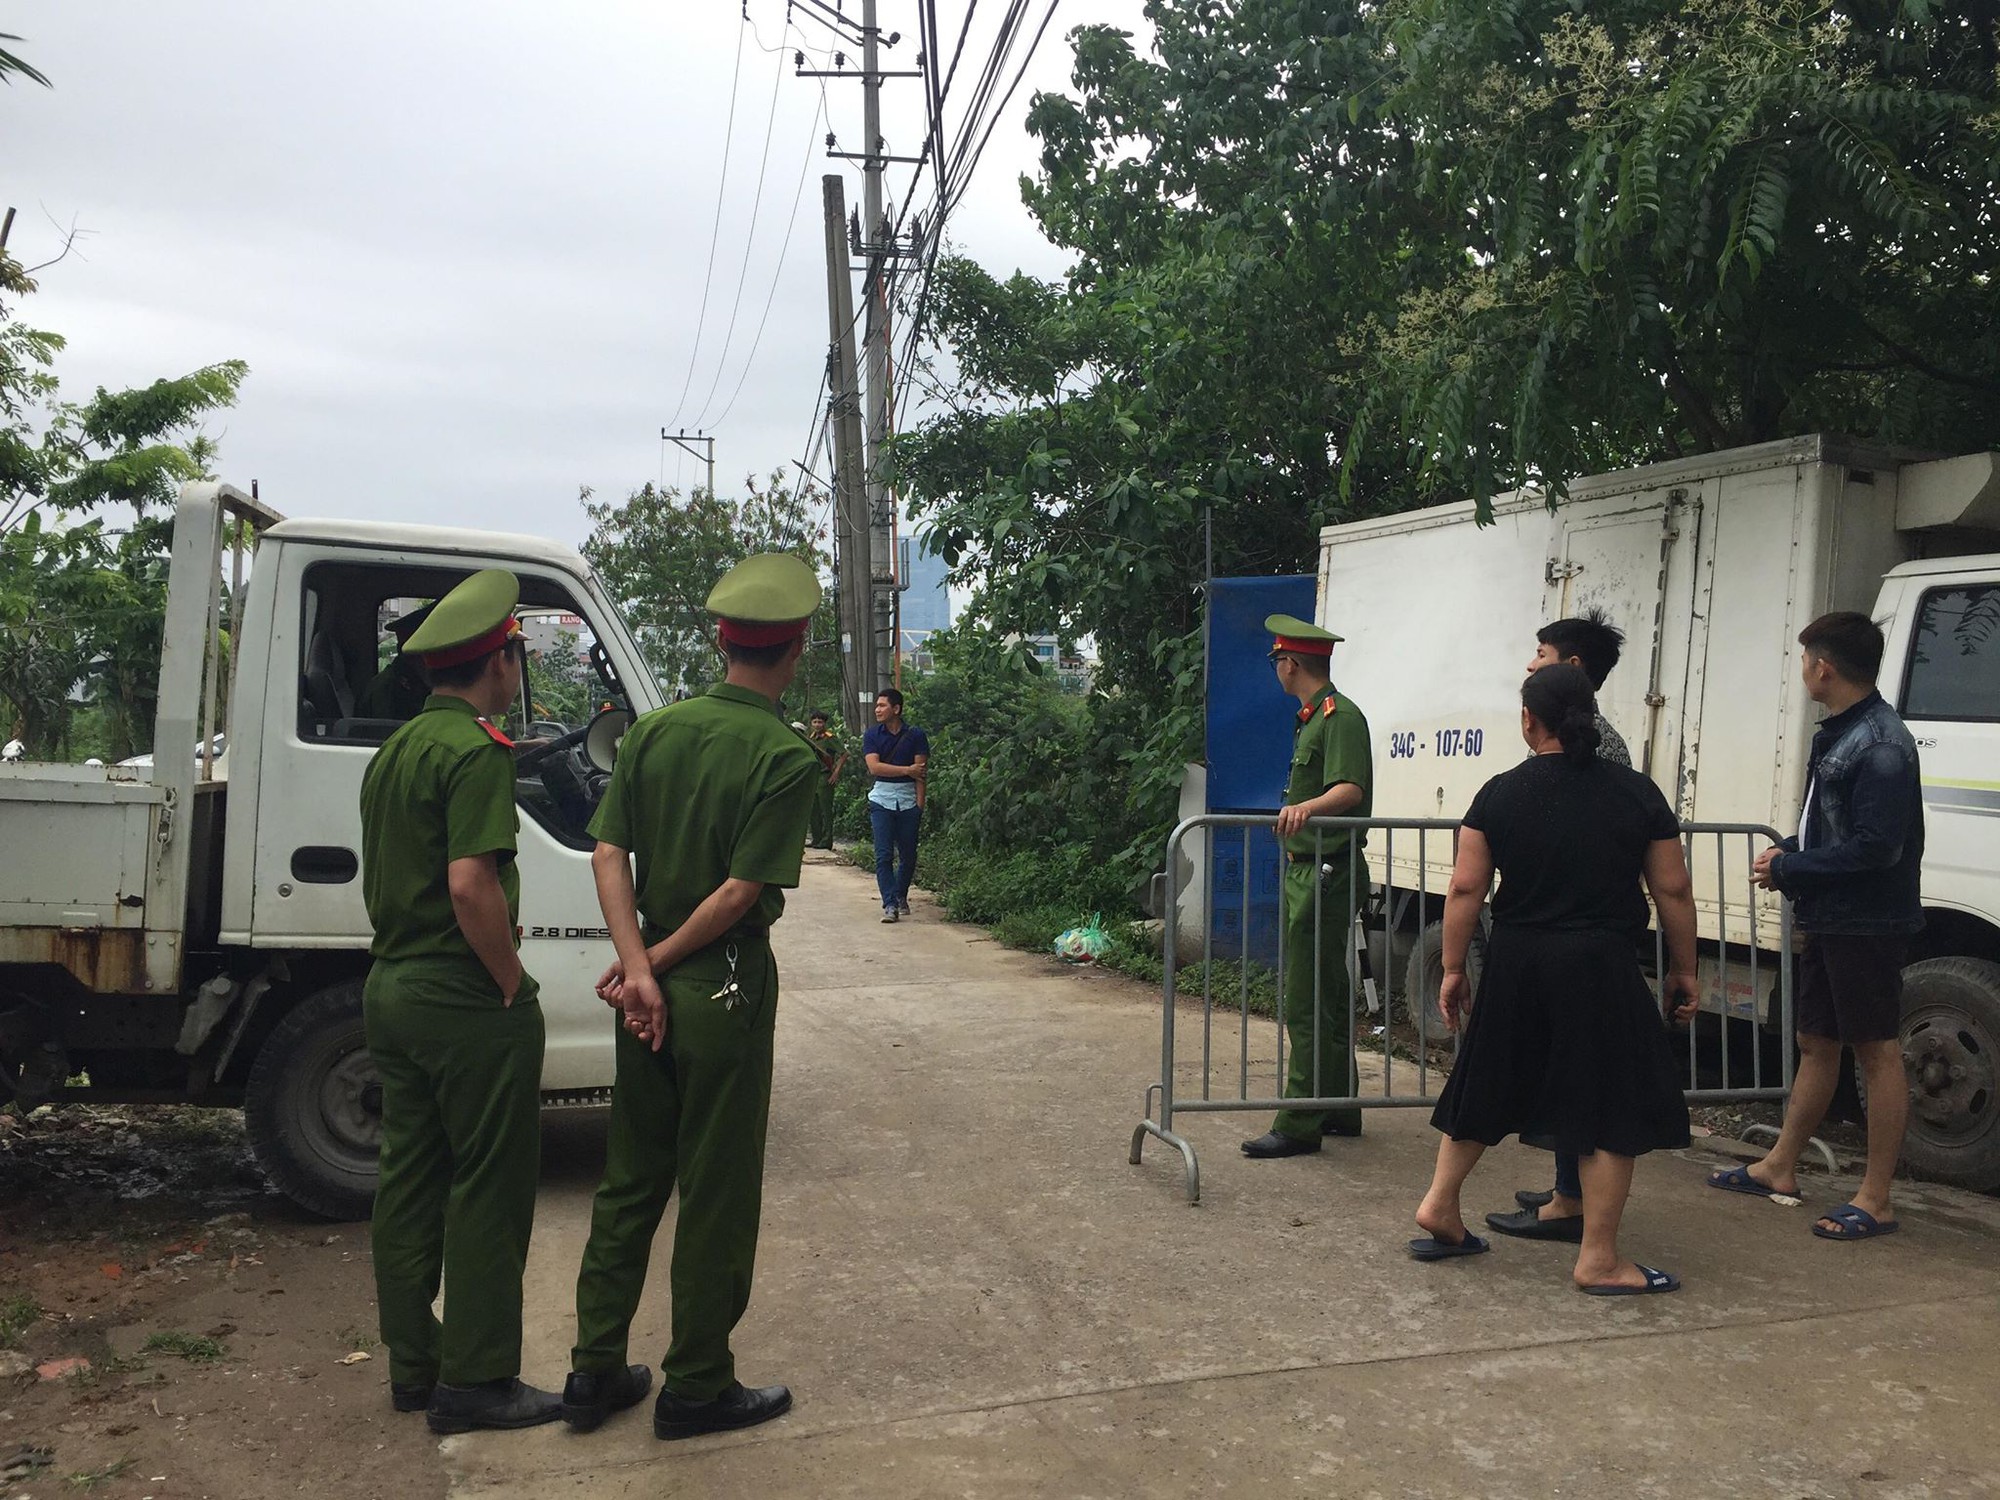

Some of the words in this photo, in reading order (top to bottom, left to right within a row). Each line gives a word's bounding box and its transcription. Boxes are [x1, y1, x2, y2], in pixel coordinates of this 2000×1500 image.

[1390, 732, 1415, 758] 34C
[532, 927, 559, 937] 2.8
[565, 928, 611, 938] DIES
